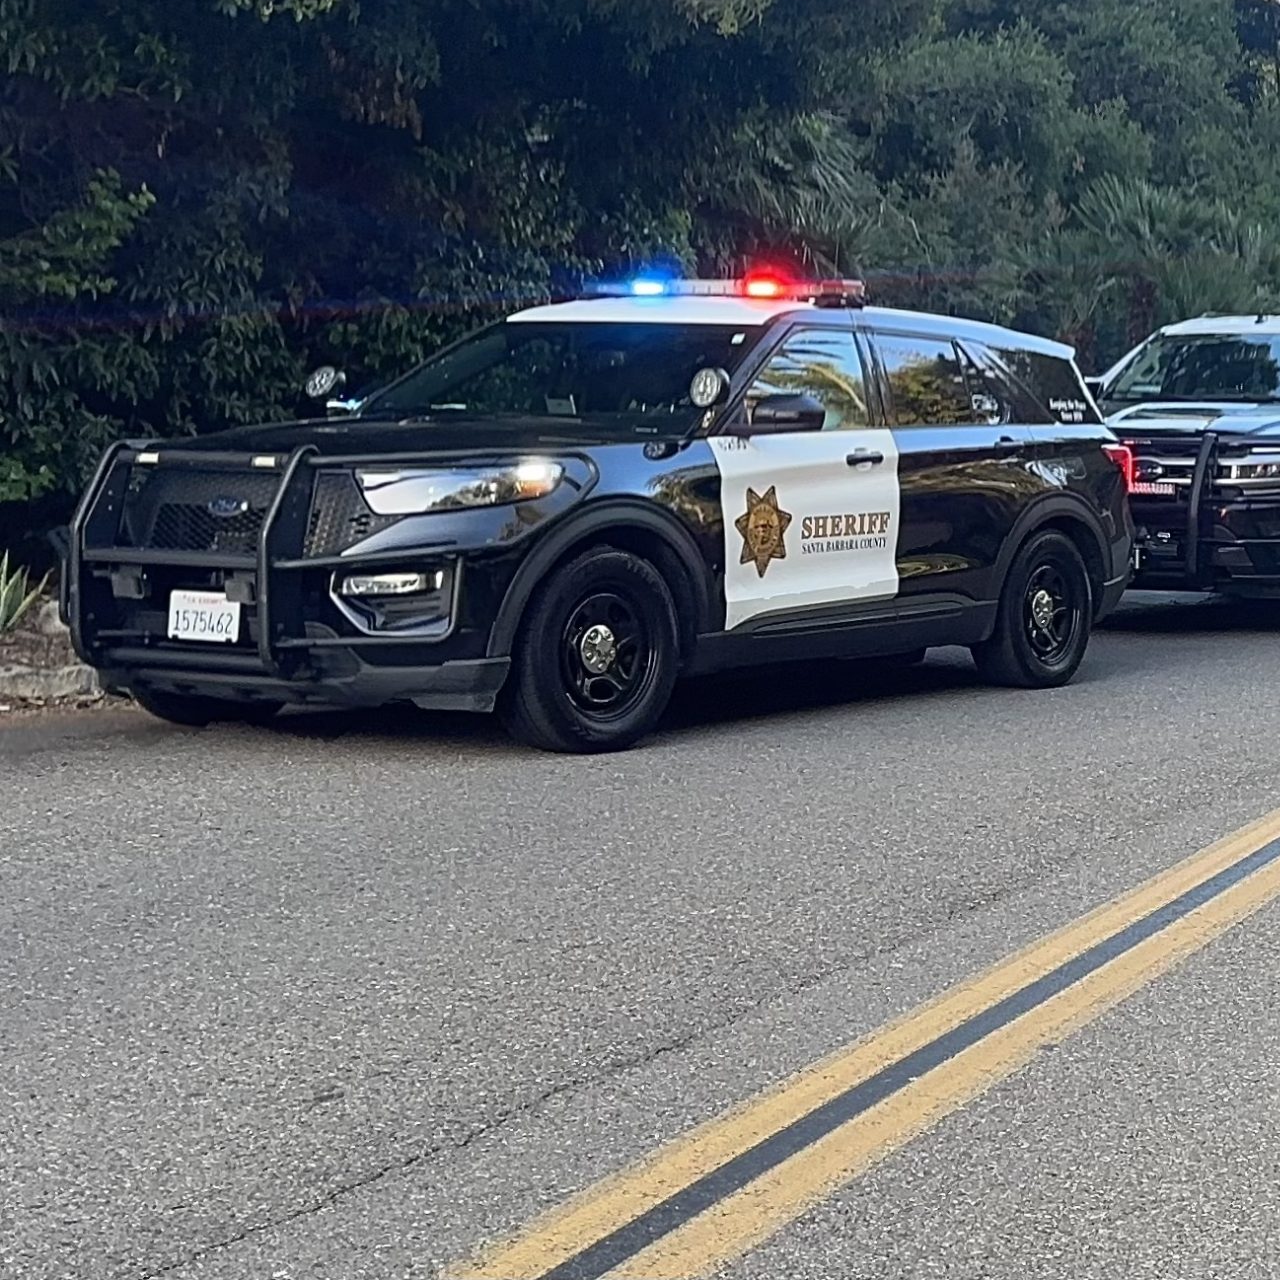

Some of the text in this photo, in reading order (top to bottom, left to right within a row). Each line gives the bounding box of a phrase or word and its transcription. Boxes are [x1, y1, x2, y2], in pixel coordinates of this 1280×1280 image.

[801, 512, 890, 539] SHERIFF
[802, 537, 887, 554] SANTA BARBARA COUNTY
[174, 610, 233, 634] 1575462
